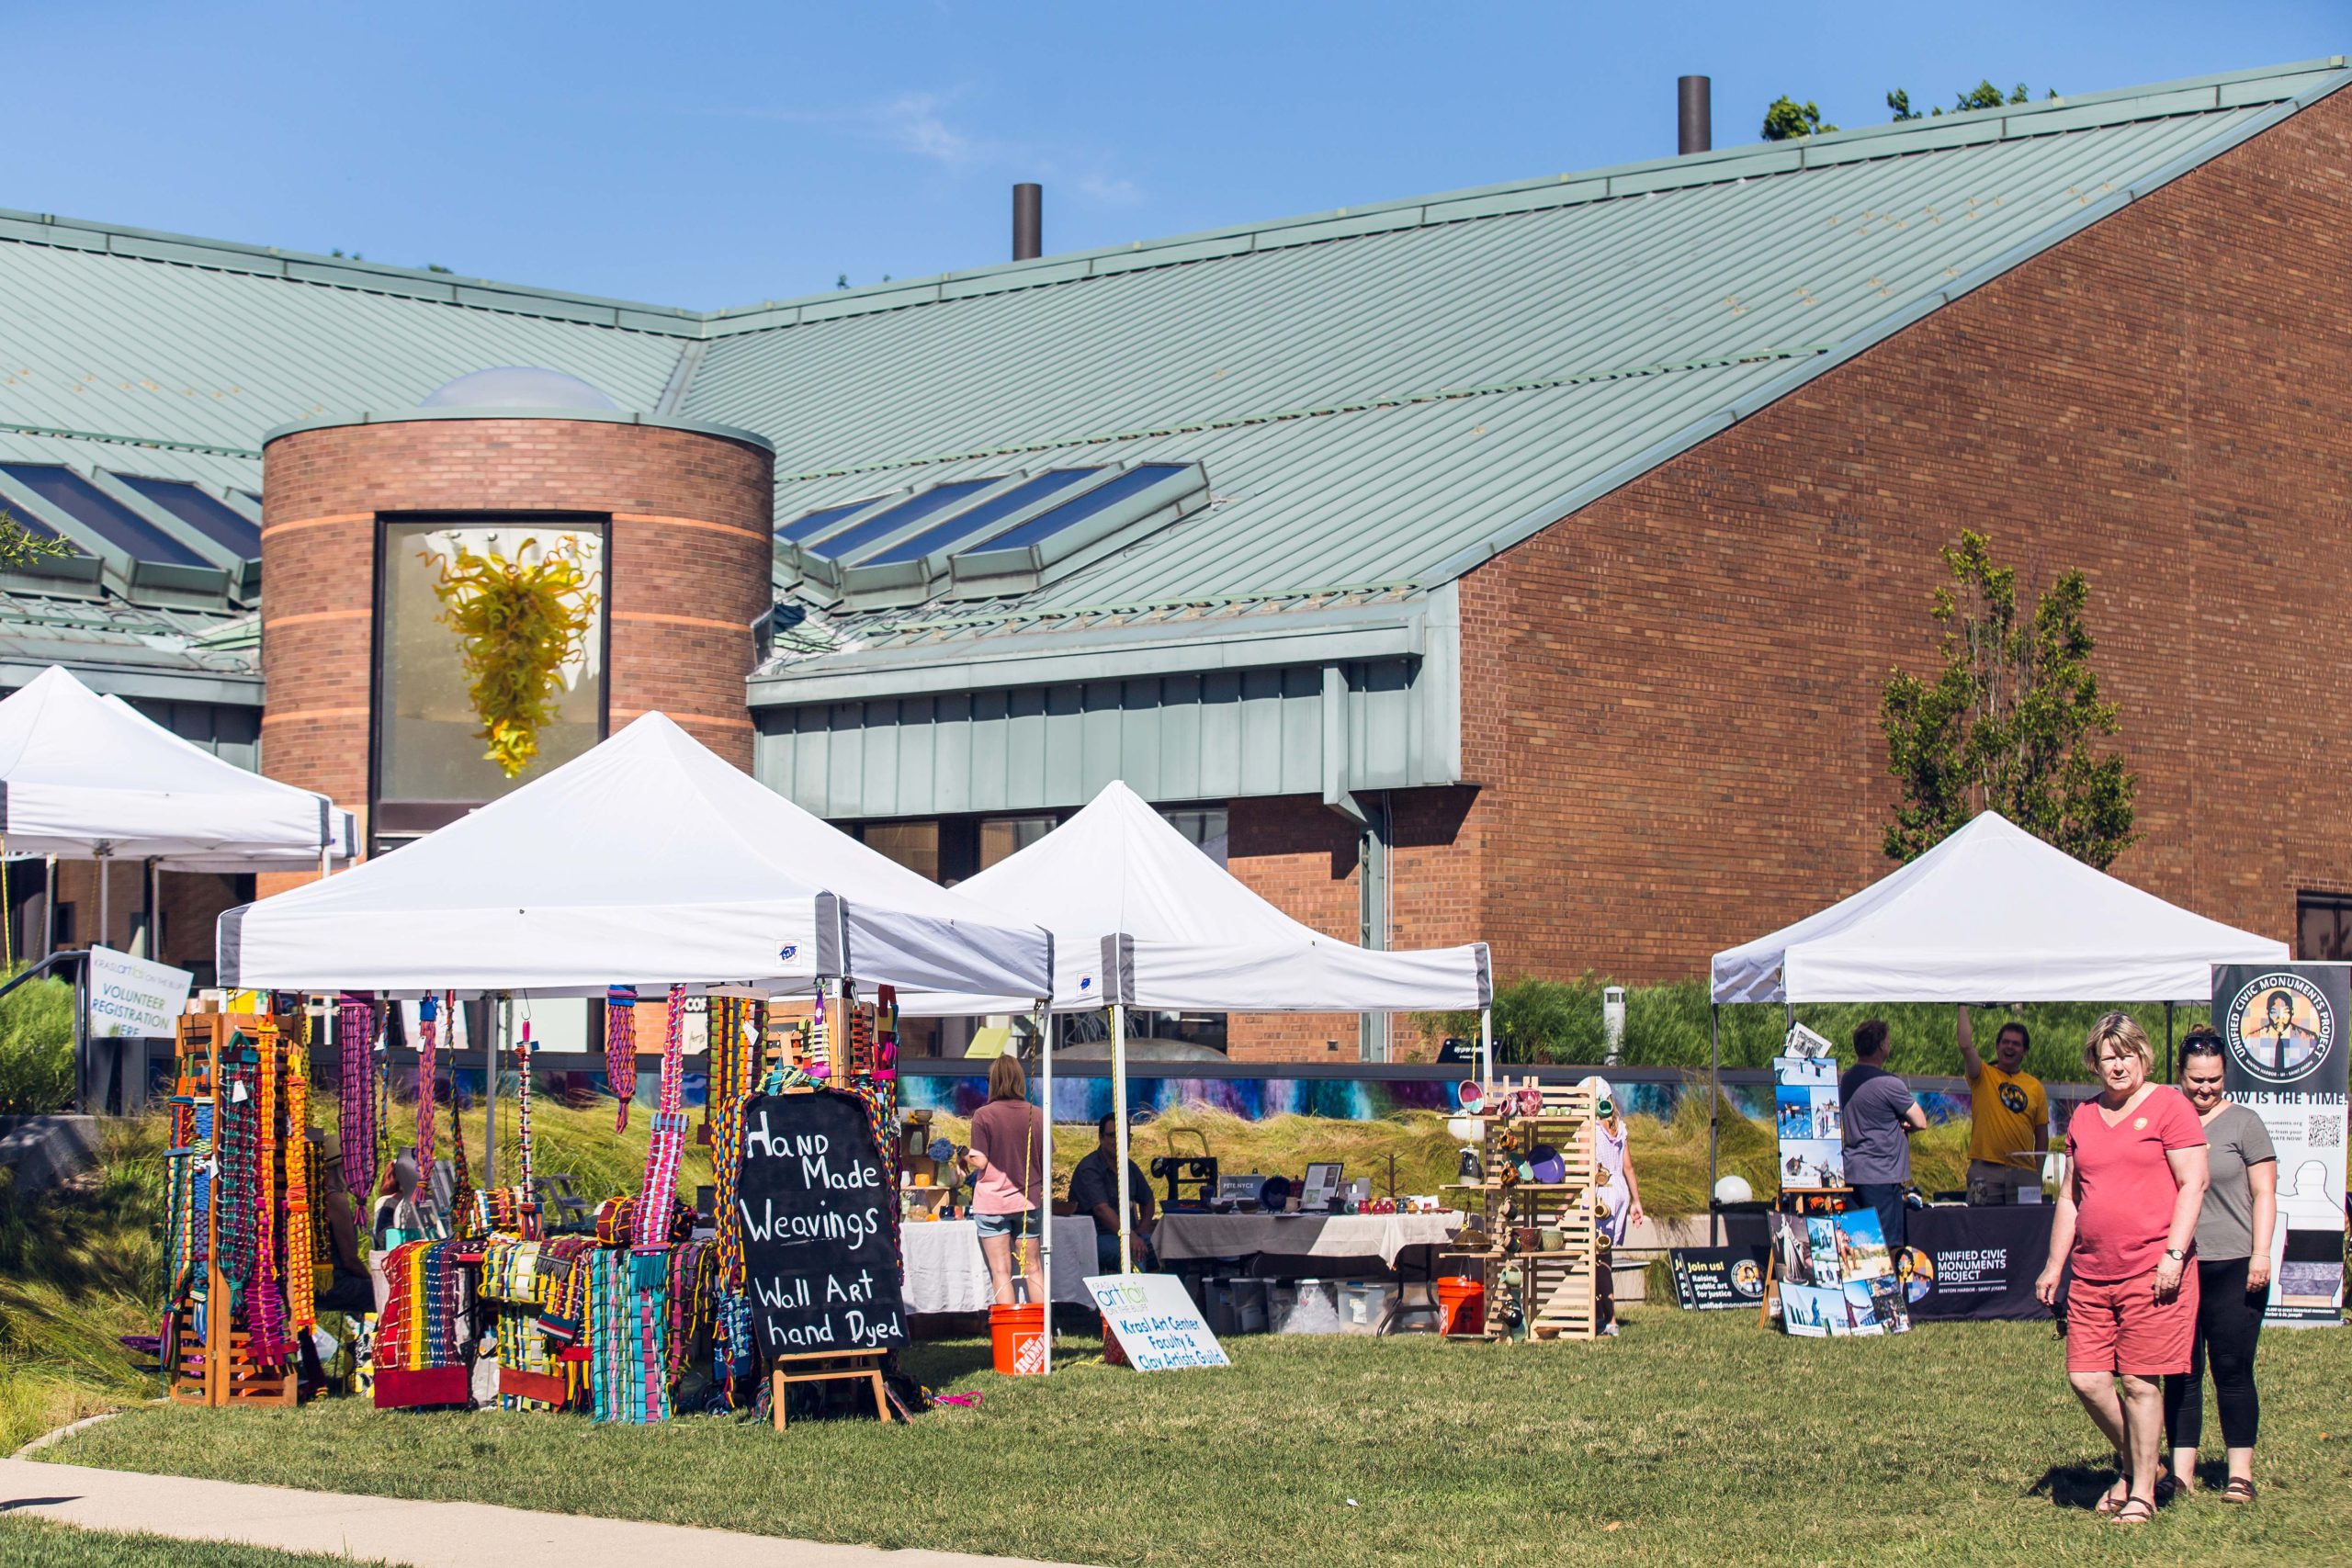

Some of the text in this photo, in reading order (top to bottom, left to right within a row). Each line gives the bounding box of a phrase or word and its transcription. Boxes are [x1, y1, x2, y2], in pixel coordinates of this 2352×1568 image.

[103, 983, 165, 1011] VOLUNTEER
[92, 998, 170, 1030] REGISTRATION
[2230, 976, 2331, 1059] UNIFIED CIVIC MONUMENTS PROJECT
[2223, 1091, 2251, 1104] OW
[2256, 1092, 2269, 1104] IS
[2275, 1092, 2301, 1105] THE
[802, 1156, 880, 1190] Made
[740, 1198, 879, 1250] Weavings
[1937, 1249, 2007, 1261] UNIFIED CIVIC
[1687, 1261, 1724, 1273] Join us!
[1938, 1259, 2007, 1271] MONUMENTS
[1691, 1274, 1718, 1283] Raising
[1938, 1270, 1981, 1282] PROJECT
[754, 1276, 810, 1309] Wall
[1097, 1283, 1125, 1306] art
[1694, 1283, 1716, 1292] public
[1709, 1290, 1733, 1299] justice
[767, 1310, 904, 1348] hand Dyed
[1119, 1315, 1200, 1334] Krasl Art Center
[1148, 1333, 1196, 1350] Faculty &
[1137, 1348, 1224, 1370] Clay Artists Guild
